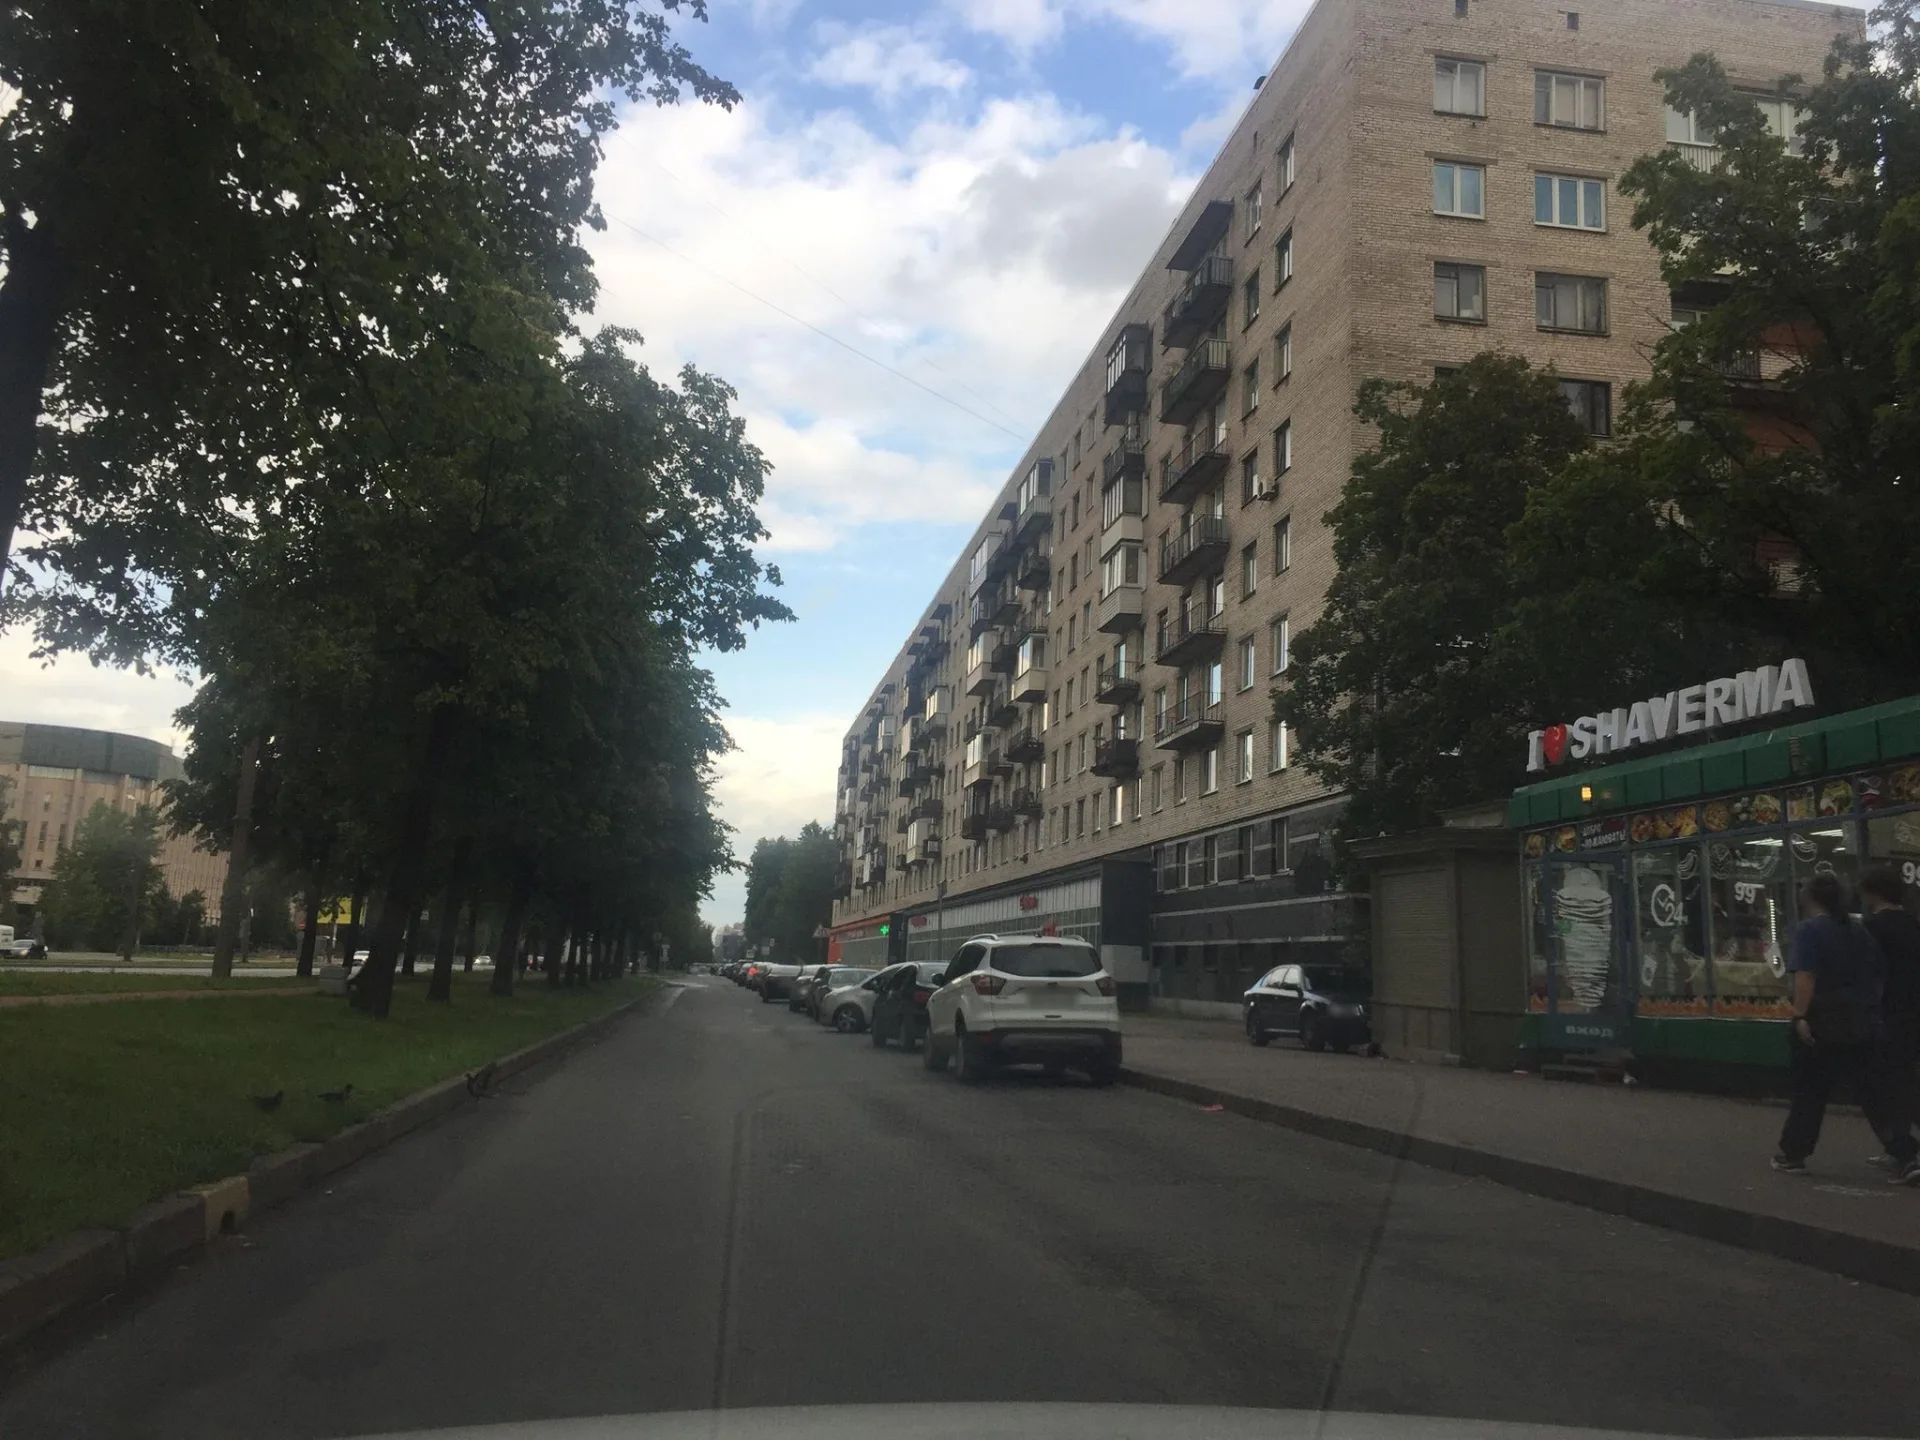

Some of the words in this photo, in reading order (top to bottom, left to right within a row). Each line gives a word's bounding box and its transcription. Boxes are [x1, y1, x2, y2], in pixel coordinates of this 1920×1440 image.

[1526, 730, 1545, 773] I
[1570, 657, 1815, 760] SHAVERMA
[1734, 881, 1756, 904] 99
